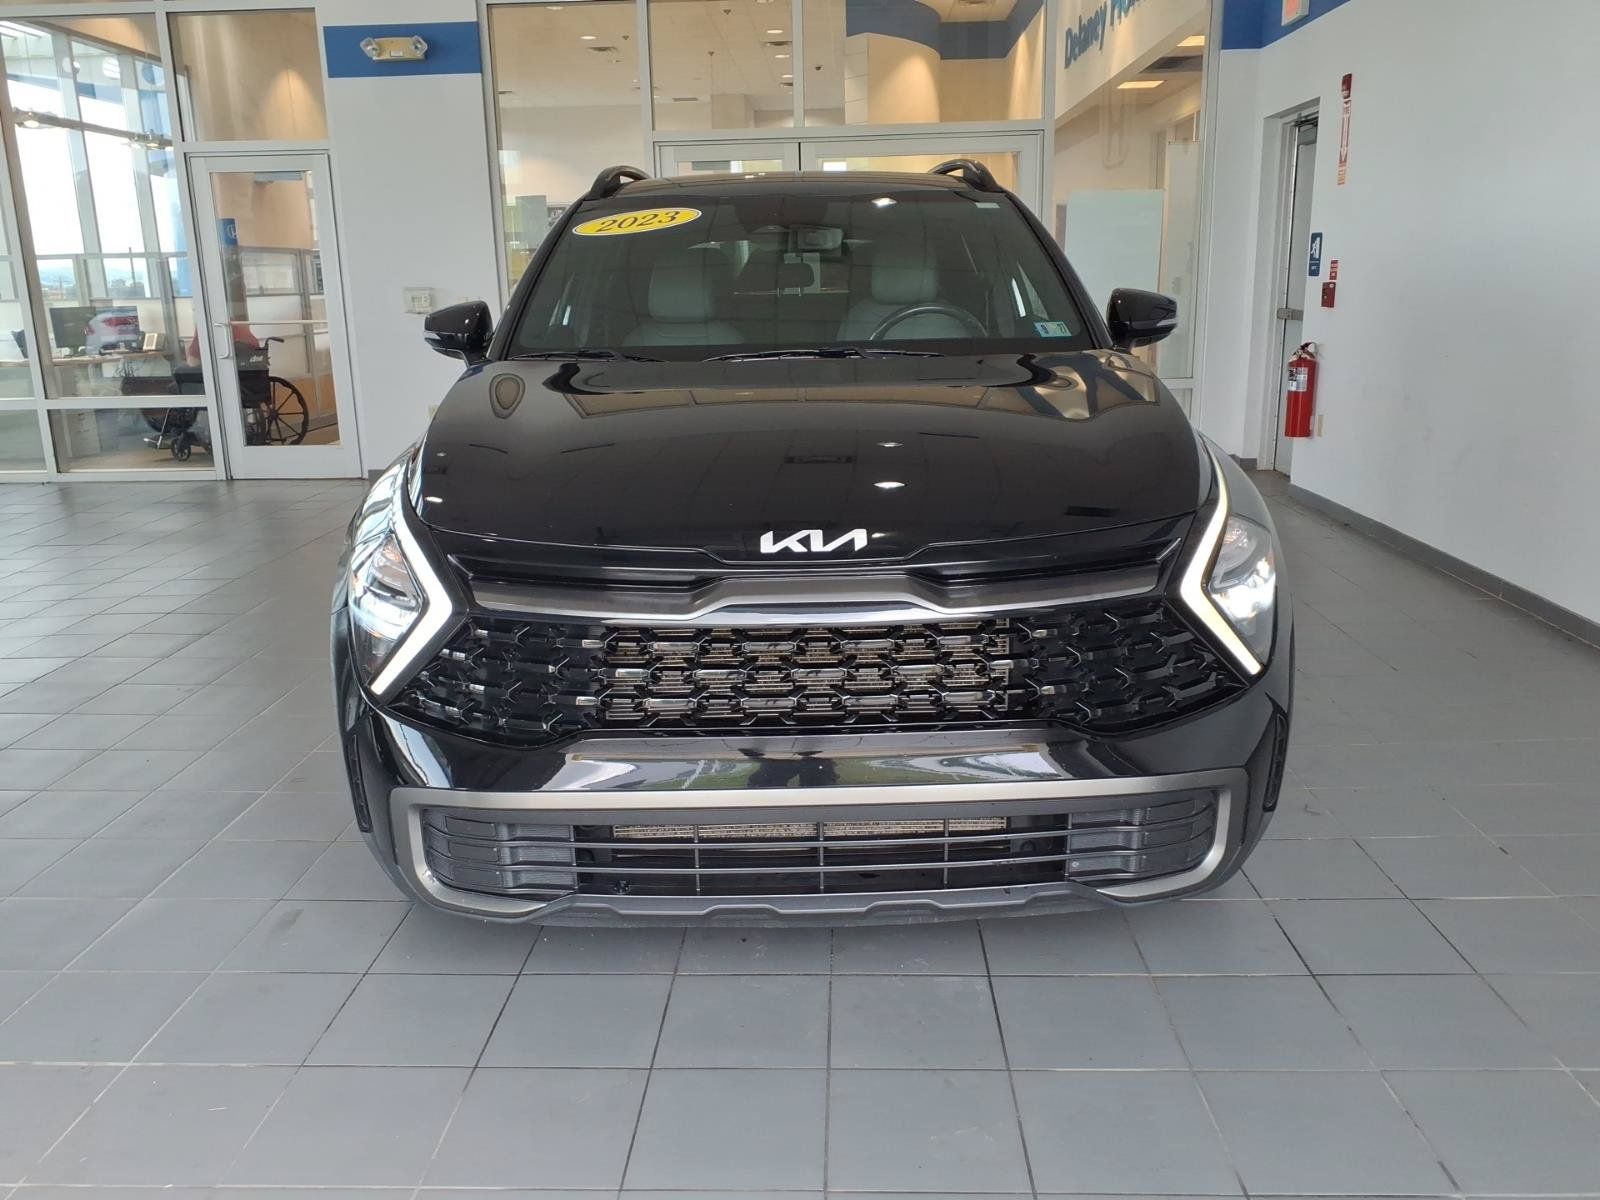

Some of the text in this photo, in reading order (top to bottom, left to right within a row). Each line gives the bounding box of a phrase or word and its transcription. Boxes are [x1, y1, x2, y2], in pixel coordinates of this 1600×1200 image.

[1064, 1, 1108, 70] Delaney
[595, 210, 681, 233] 2023
[760, 528, 868, 554] KIA
